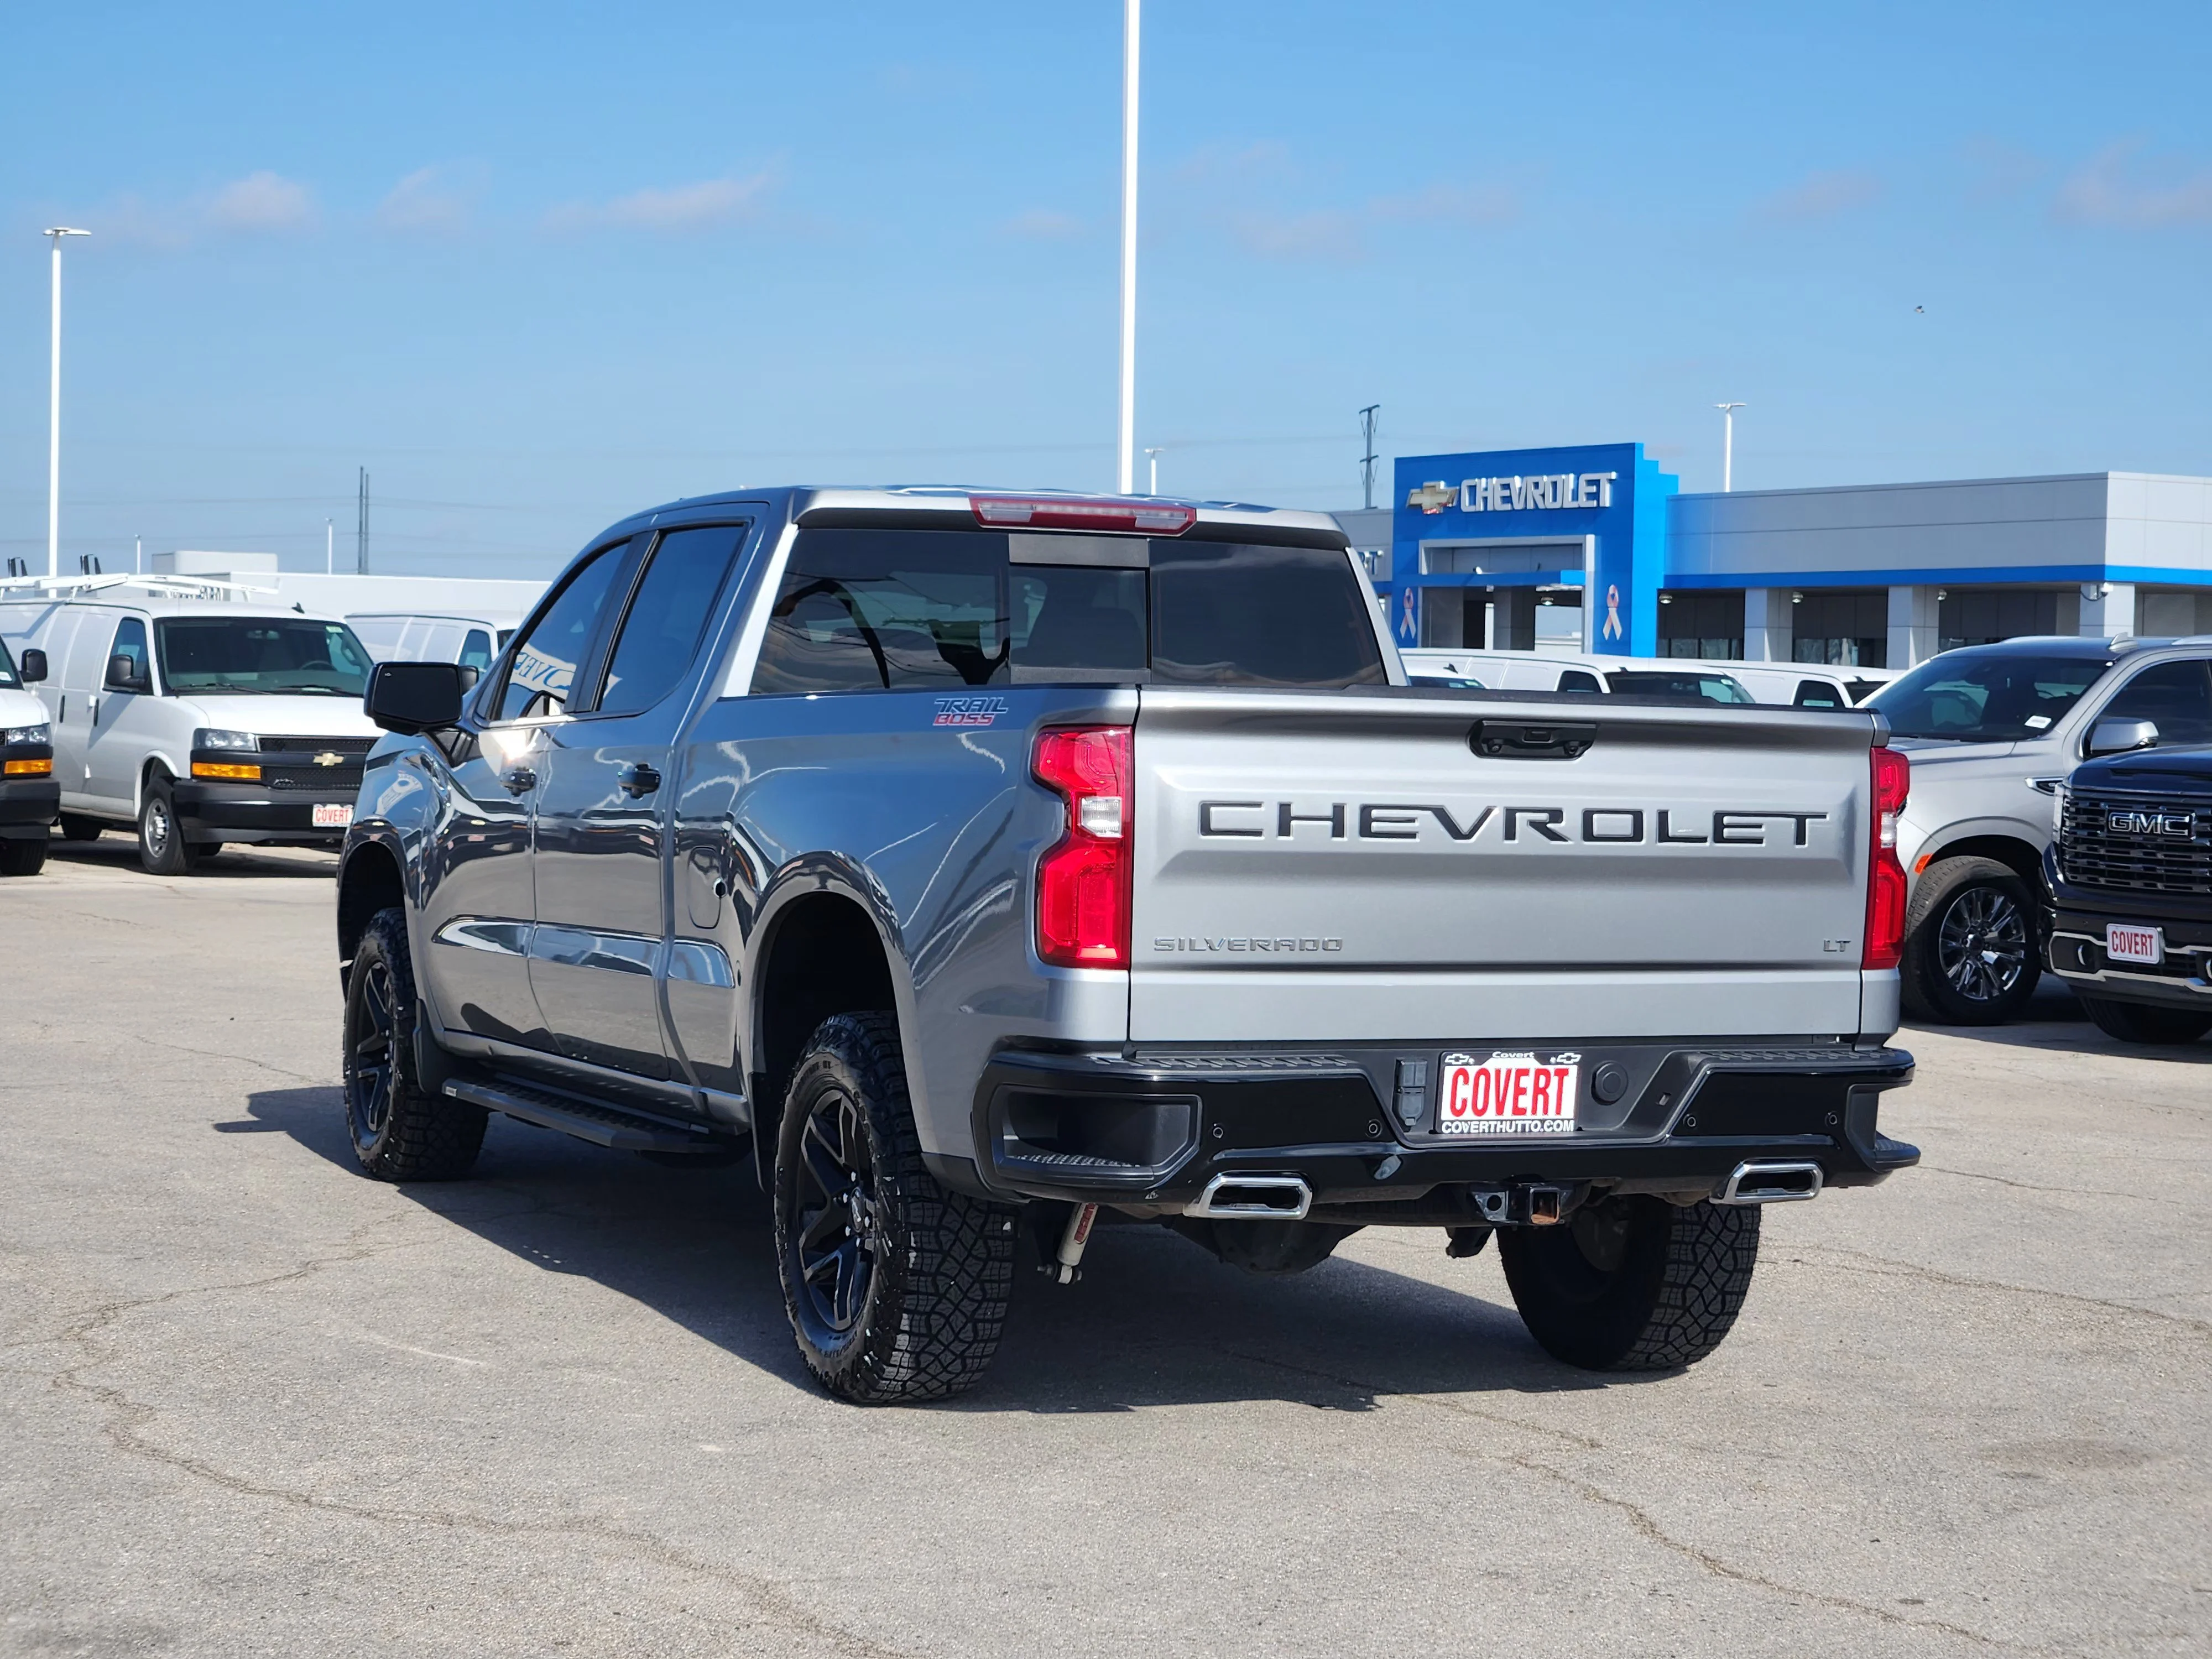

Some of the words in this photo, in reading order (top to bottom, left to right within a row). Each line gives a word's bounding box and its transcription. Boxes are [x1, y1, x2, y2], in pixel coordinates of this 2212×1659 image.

[1460, 471, 1616, 512] CHEVROLET
[934, 697, 1009, 713] TRAIL
[933, 712, 995, 726] BOSS
[316, 809, 348, 822] COVERT
[1198, 801, 1829, 847] CHEVROLET
[2109, 812, 2189, 836] GMC
[1154, 937, 1342, 951] SILVERADO
[1823, 940, 1851, 952] LT
[2111, 931, 2153, 956] COVERT
[1450, 1067, 1569, 1117] COVERT
[1442, 1120, 1575, 1133] COVERTHUTTO.COM
